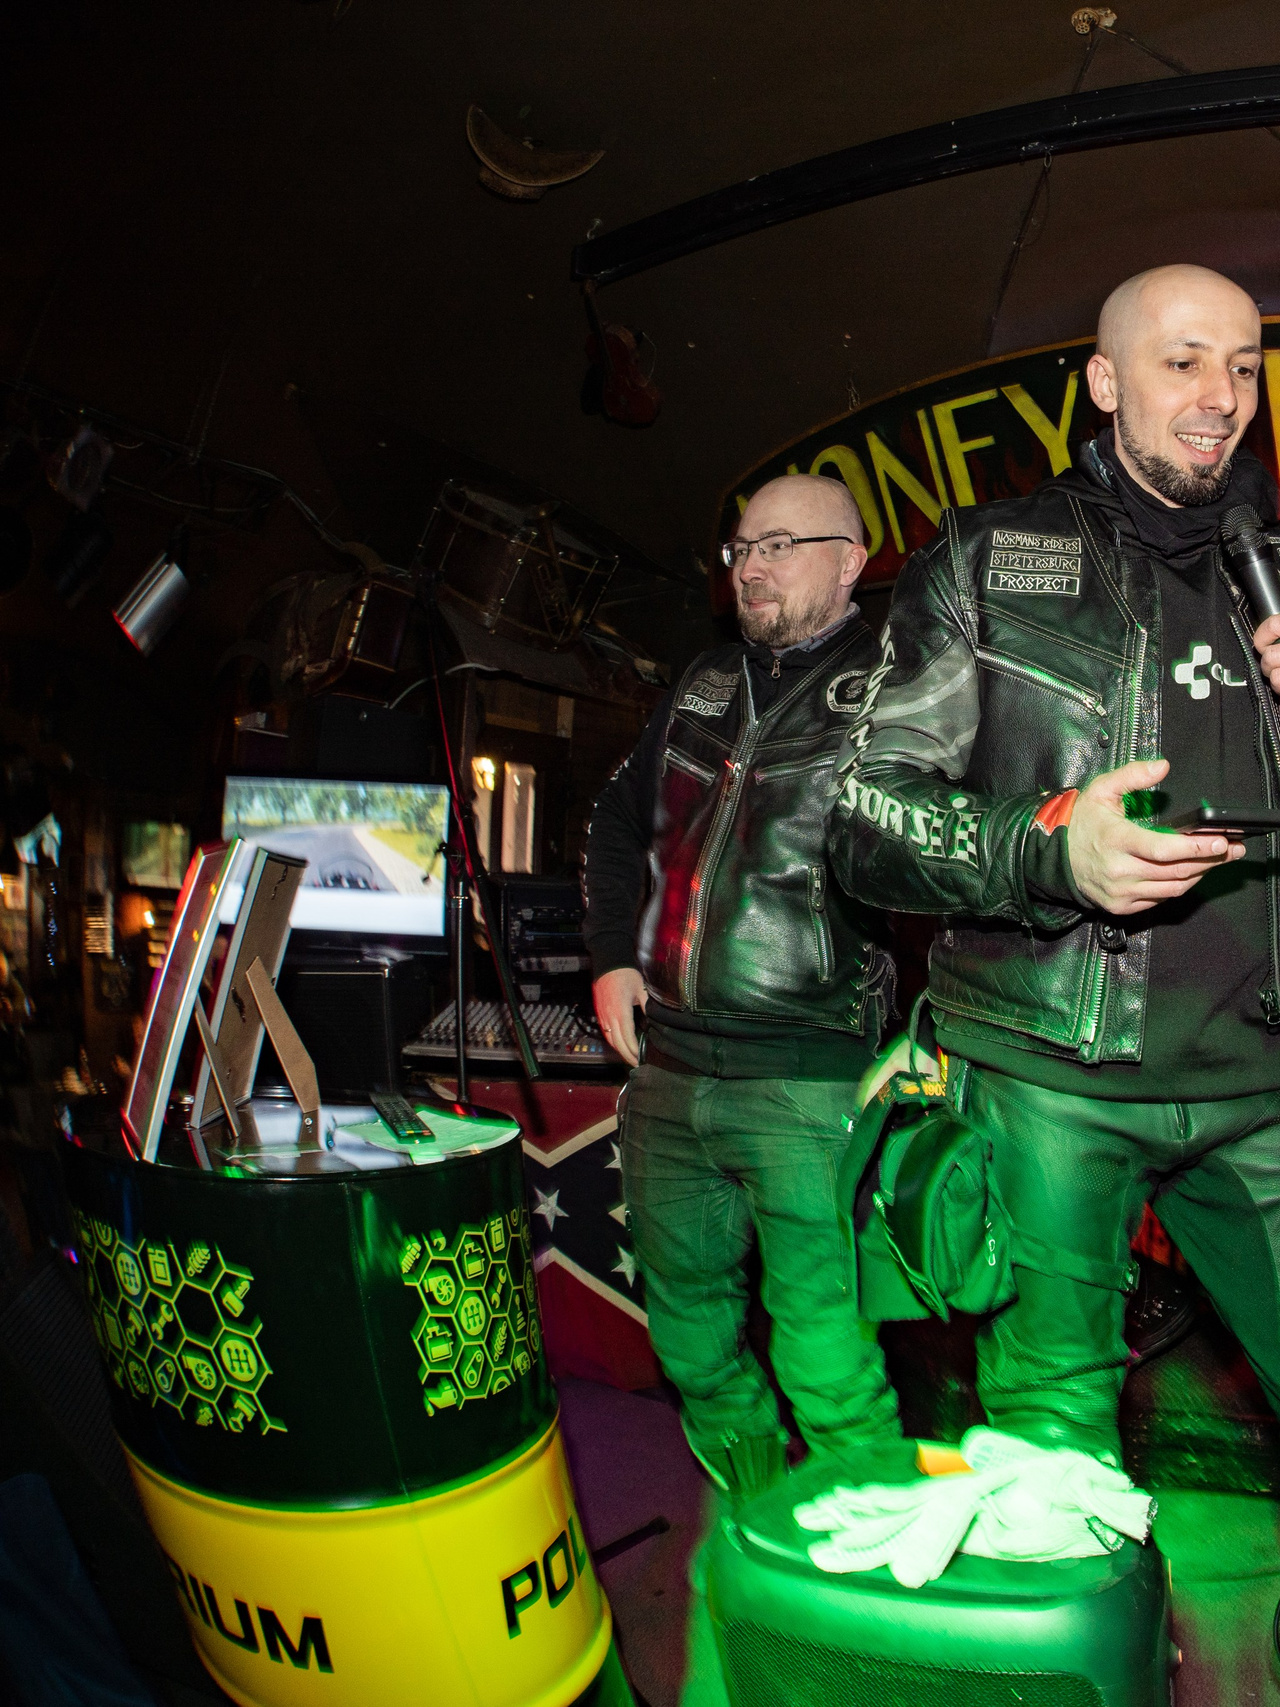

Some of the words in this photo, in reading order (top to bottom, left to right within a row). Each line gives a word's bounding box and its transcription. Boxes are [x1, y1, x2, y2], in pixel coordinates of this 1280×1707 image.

[737, 371, 1079, 558] ONEY
[996, 532, 1040, 547] NORMANS
[1043, 537, 1078, 551] RIDERS
[998, 574, 1071, 591] PROSPECT
